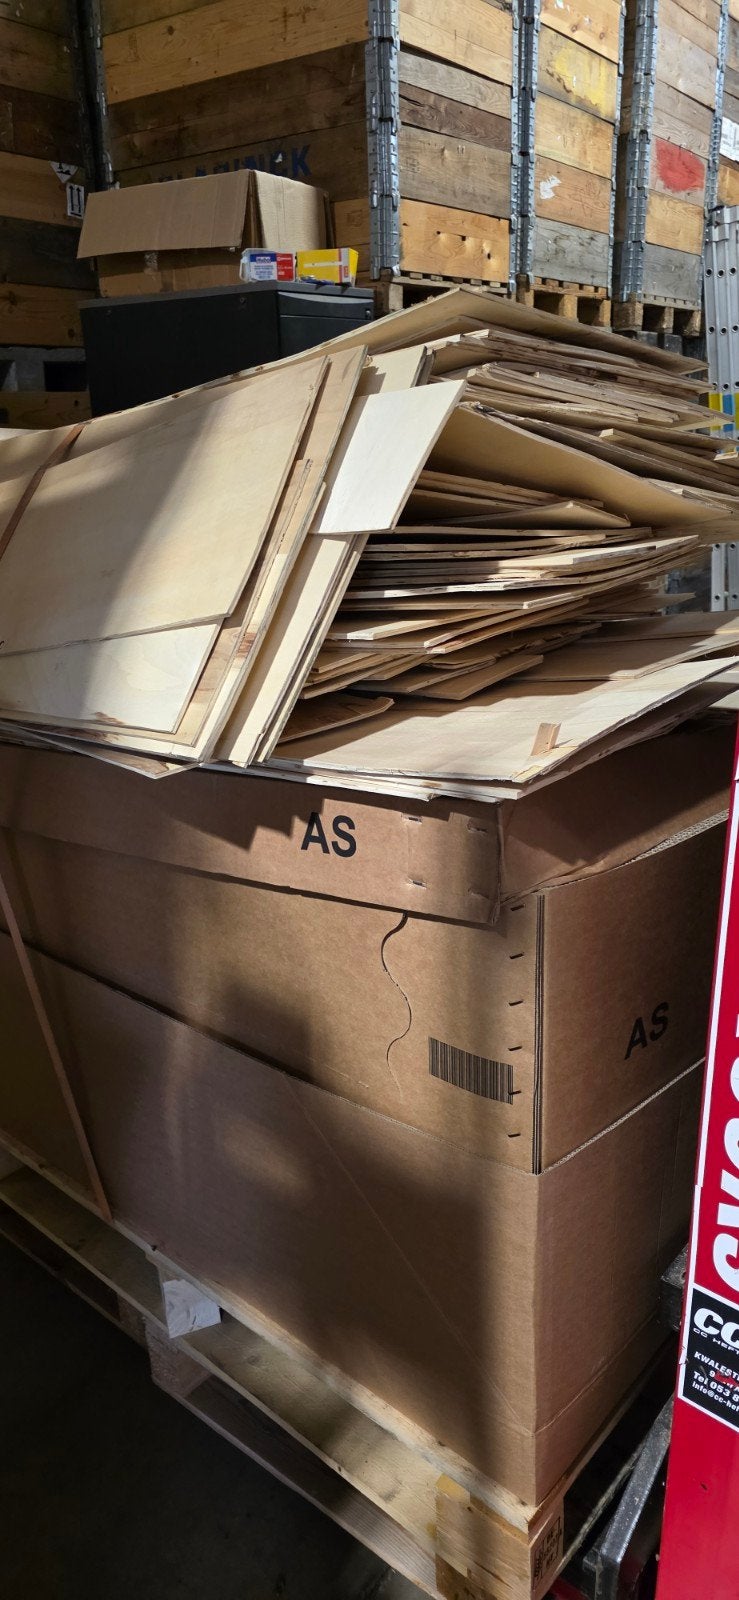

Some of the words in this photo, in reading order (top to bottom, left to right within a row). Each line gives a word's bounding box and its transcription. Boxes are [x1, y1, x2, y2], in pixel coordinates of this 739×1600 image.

[301, 811, 357, 858] AS
[624, 1001, 669, 1060] AS
[693, 1371, 708, 1385] Tel
[709, 1381, 732, 1398] 053
